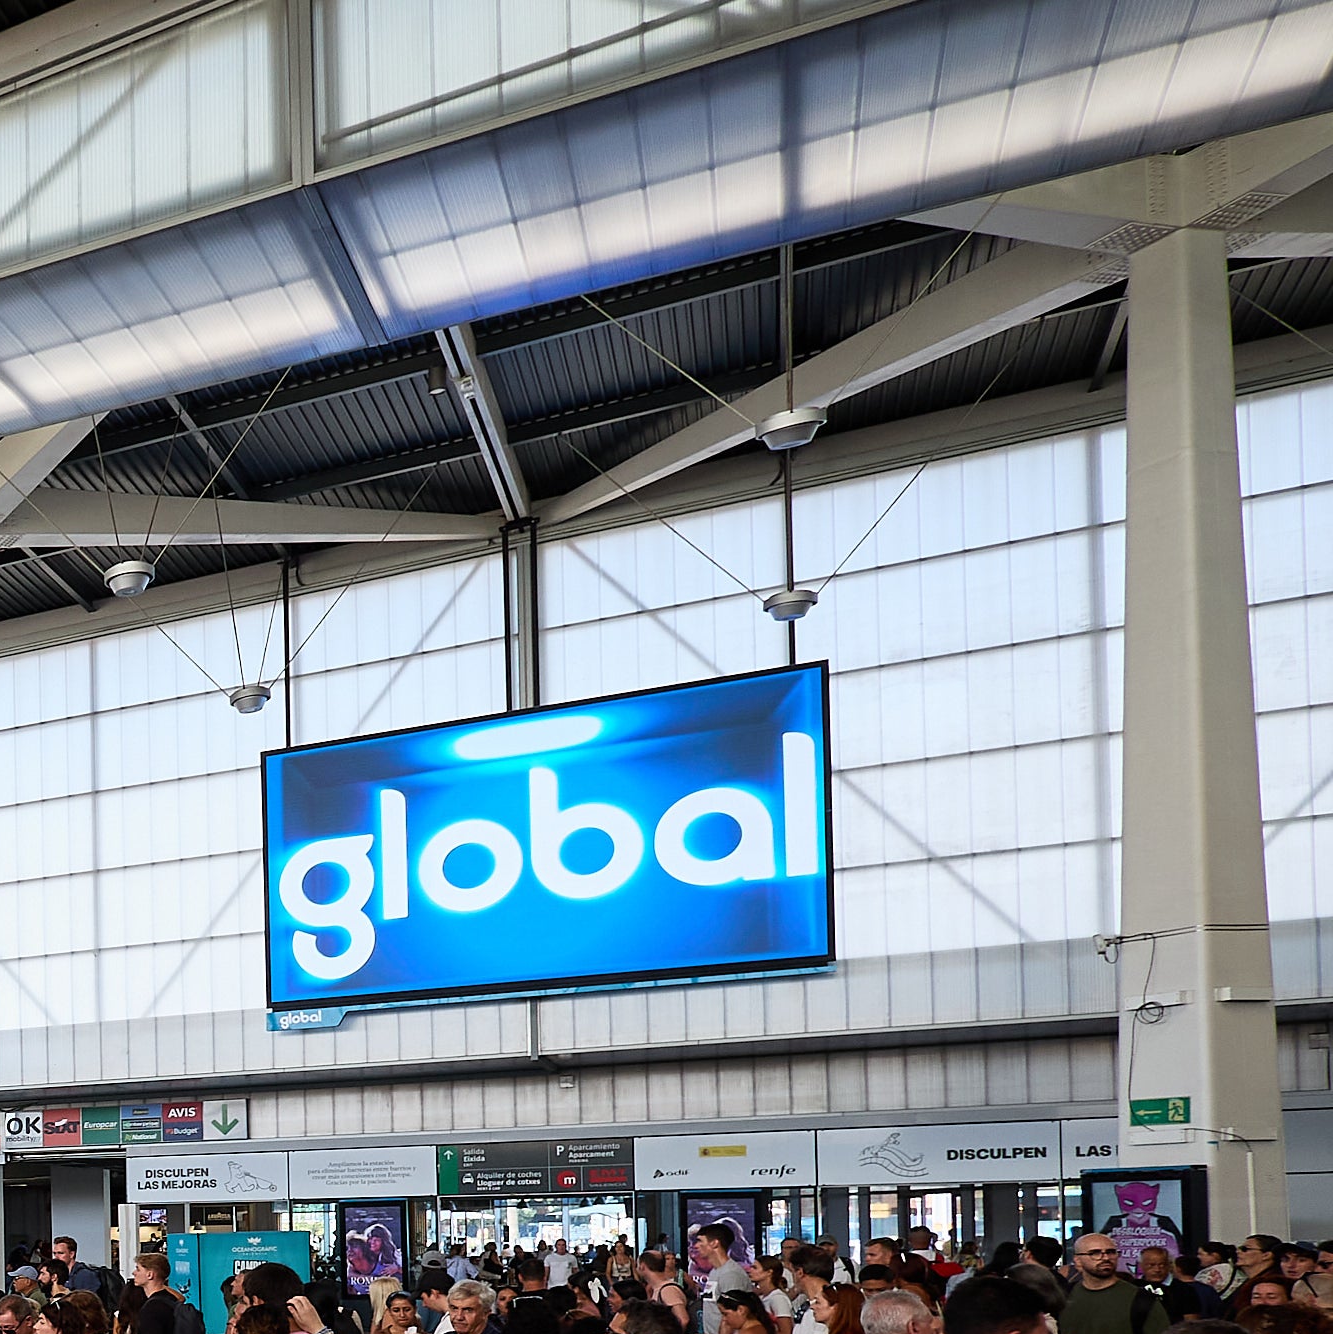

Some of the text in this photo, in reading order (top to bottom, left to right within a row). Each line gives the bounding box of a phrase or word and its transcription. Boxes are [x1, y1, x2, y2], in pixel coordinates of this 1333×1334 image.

[279, 732, 818, 980] global
[279, 1009, 322, 1029] global
[167, 1106, 196, 1119] AVIS
[6, 1116, 41, 1135] OK
[83, 1120, 118, 1130] Europcar
[173, 1126, 199, 1137] Budget
[463, 1148, 485, 1156] Salida
[556, 1145, 565, 1156] P
[568, 1143, 621, 1152] Aparcamiento
[946, 1144, 1047, 1162] DISCULPEN
[1076, 1145, 1112, 1158] LAS
[463, 1155, 486, 1164] Eixida
[568, 1150, 615, 1159] Aparcament
[145, 1168, 209, 1179] DISCULPEN
[476, 1170, 542, 1181] Alquiler de coches
[751, 1164, 796, 1179] renfe
[137, 1179, 217, 1190] LAS MEJORAS
[476, 1178, 541, 1188] Lloguer de cotxes
[350, 1276, 377, 1286] ROM
